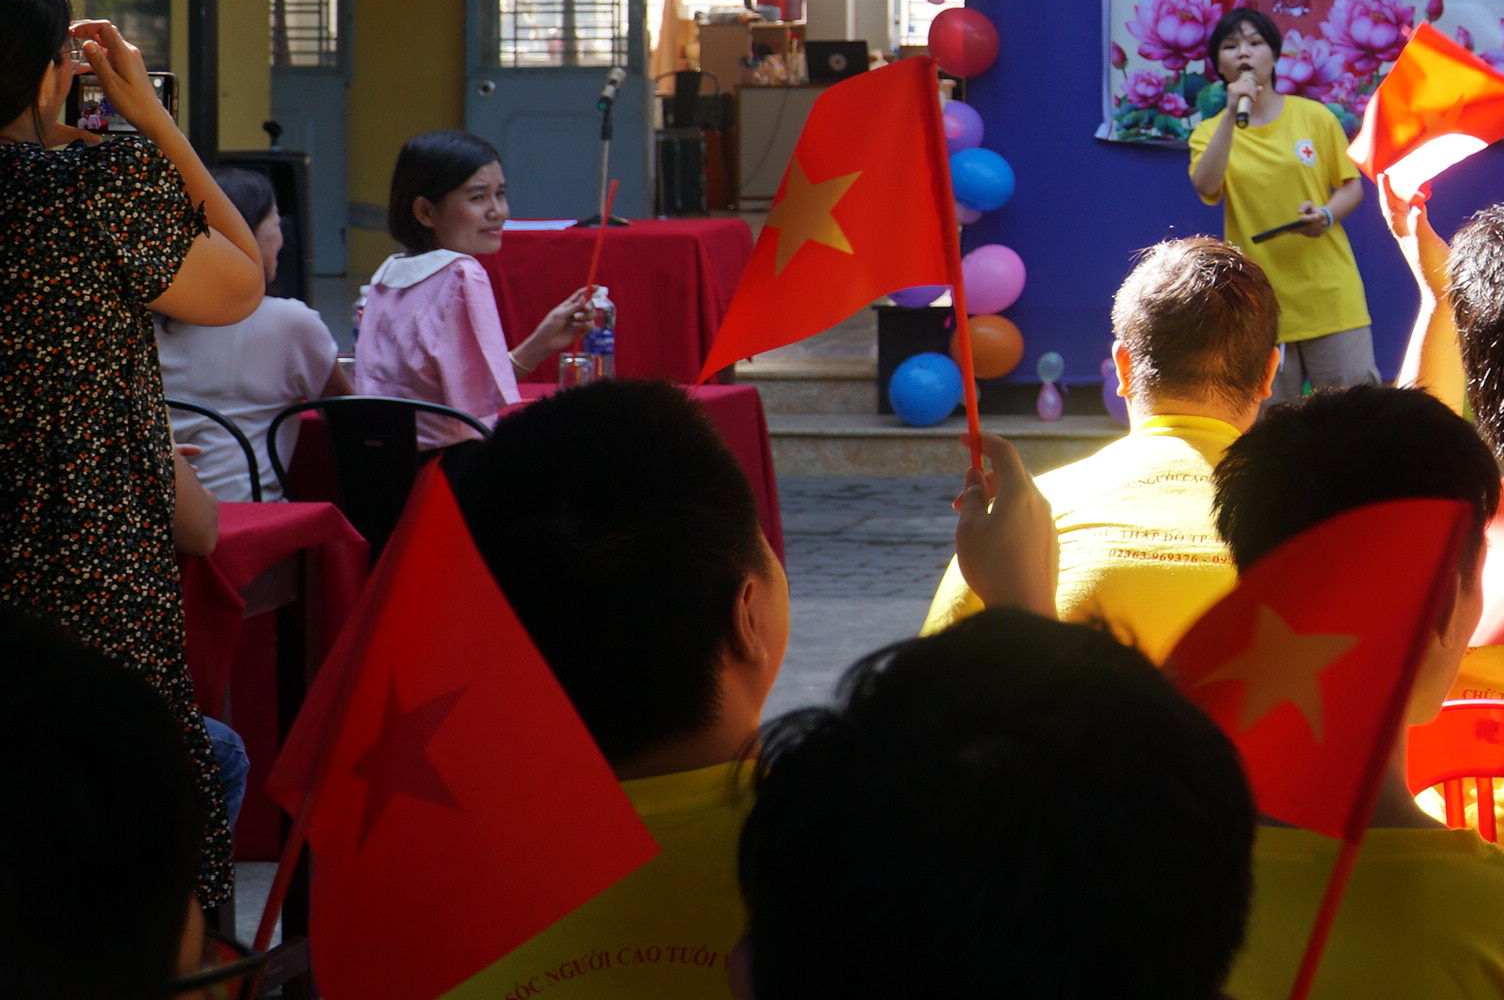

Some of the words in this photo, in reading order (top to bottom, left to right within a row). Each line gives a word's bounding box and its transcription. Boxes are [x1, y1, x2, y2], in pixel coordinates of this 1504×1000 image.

[544, 948, 613, 987] NGƯỜI
[616, 945, 662, 967] CAO
[667, 943, 718, 969] TUỔI
